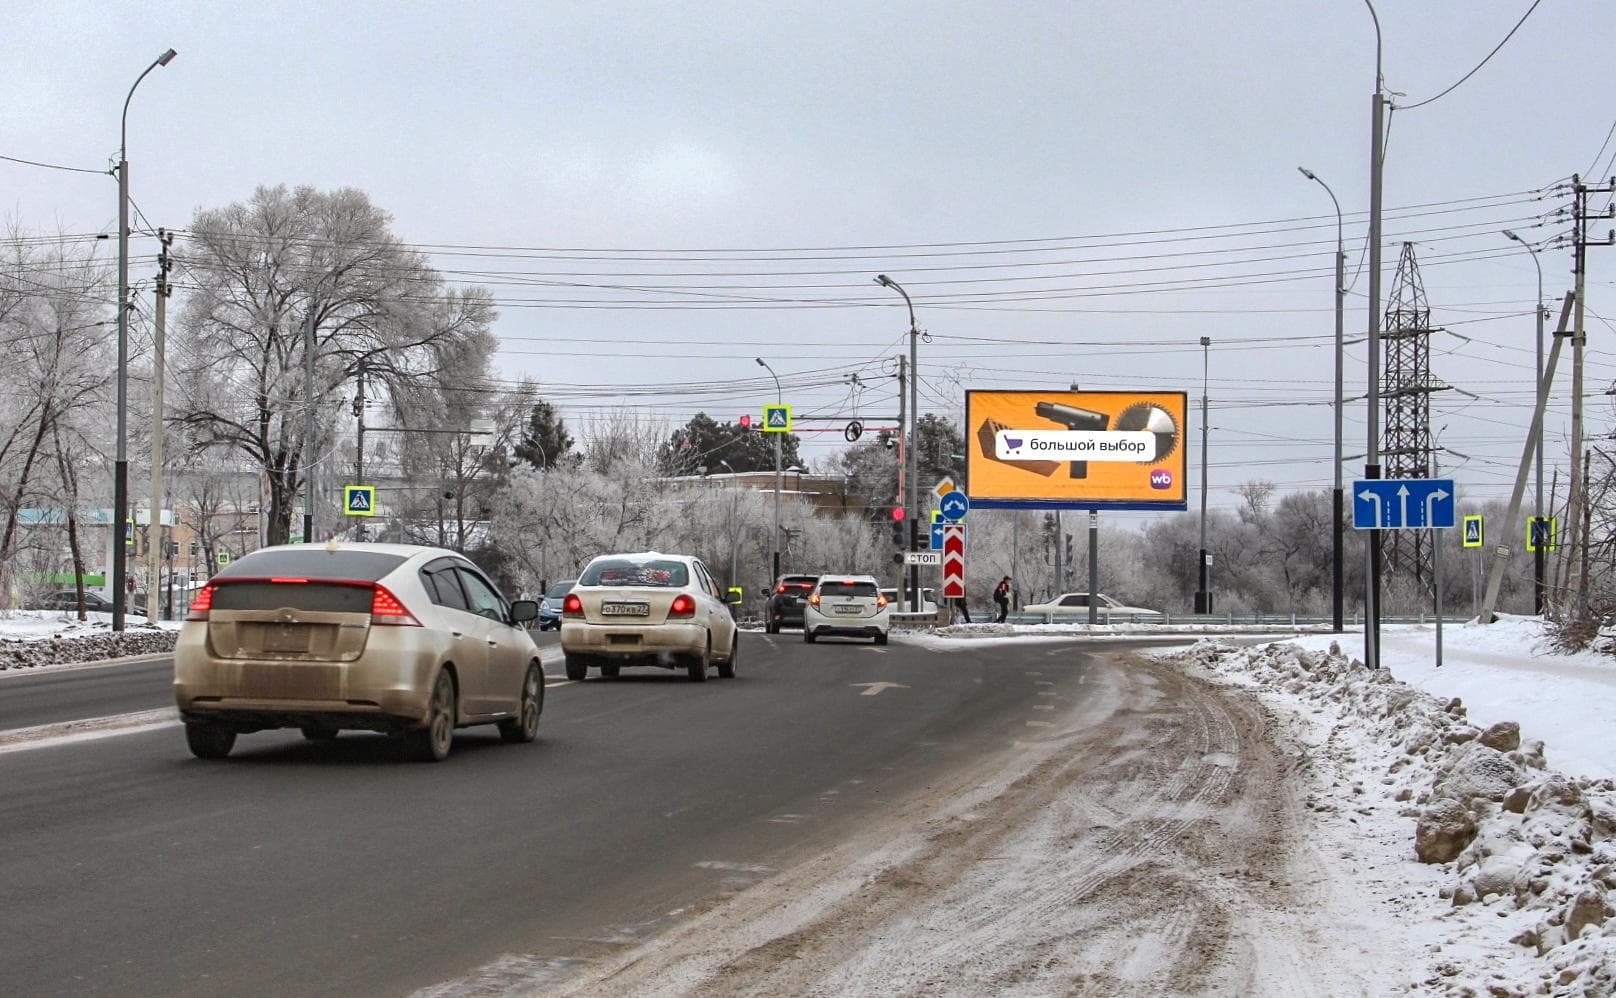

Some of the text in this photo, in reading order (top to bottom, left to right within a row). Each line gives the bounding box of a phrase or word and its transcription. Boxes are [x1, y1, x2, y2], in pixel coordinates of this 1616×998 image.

[1030, 438, 1146, 454] большой выбор
[1151, 473, 1171, 485] wb
